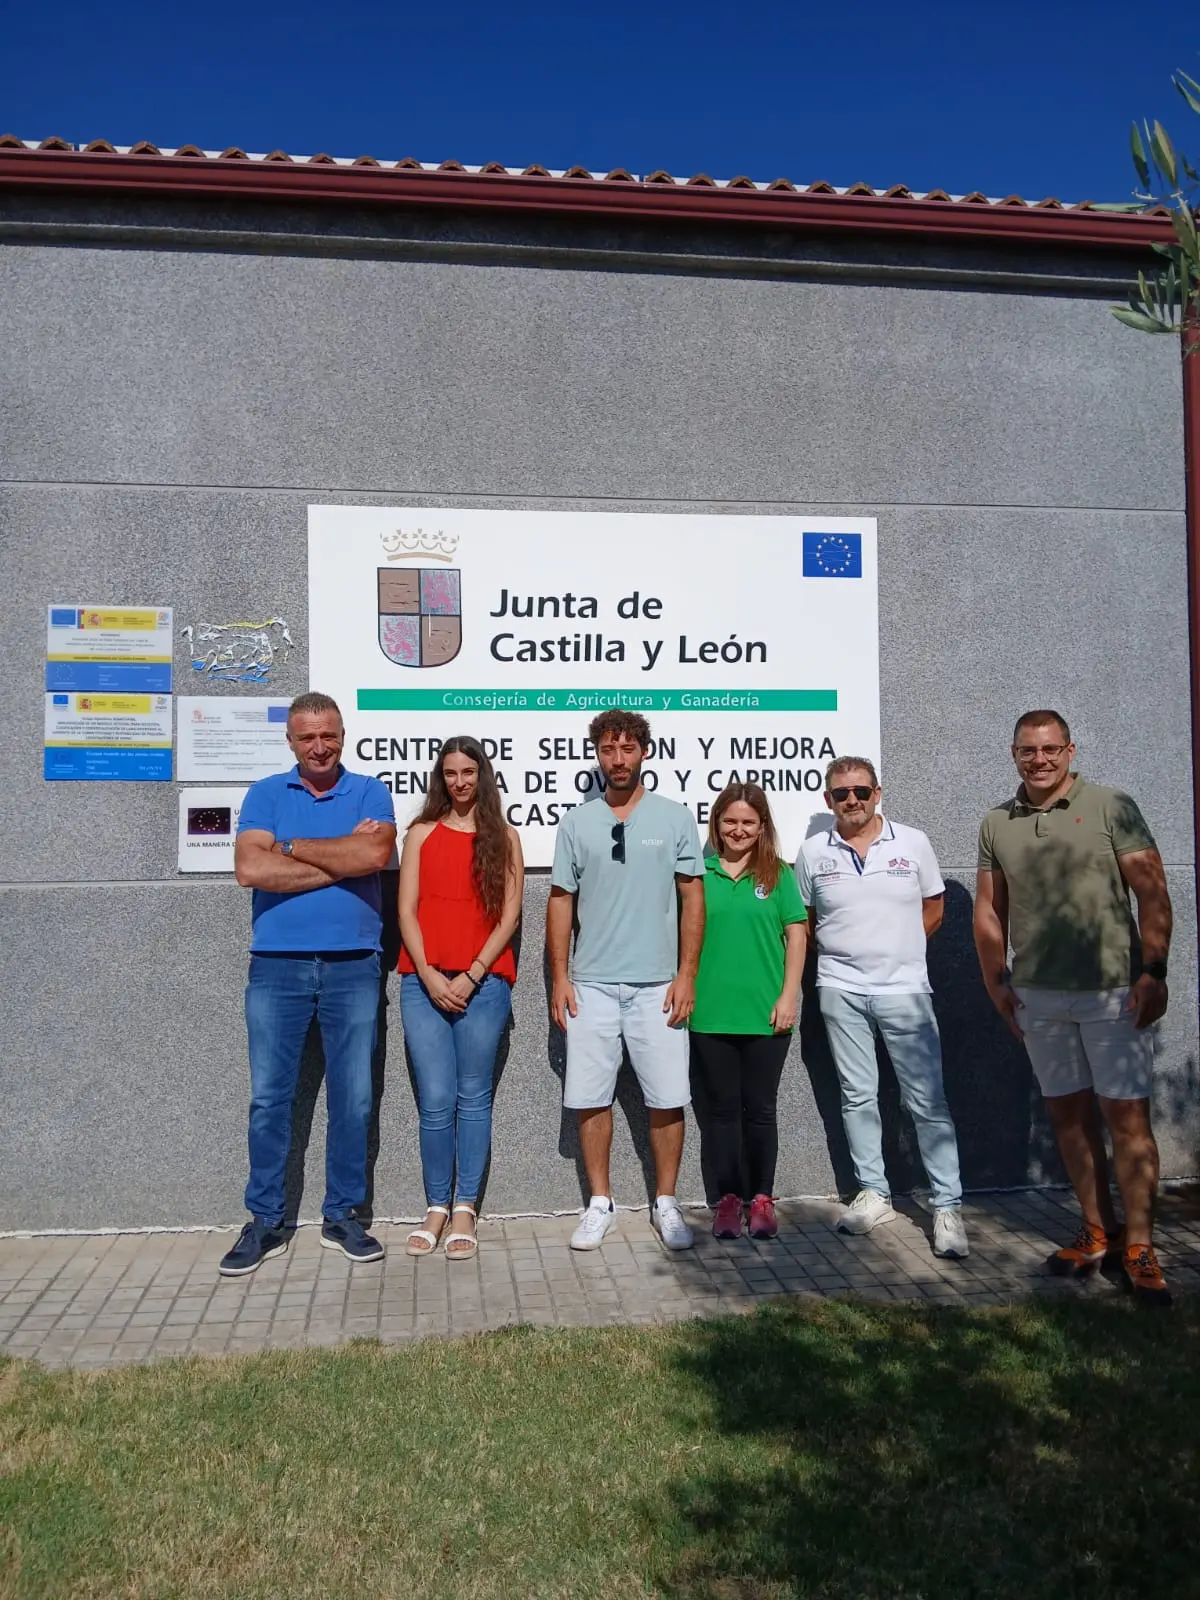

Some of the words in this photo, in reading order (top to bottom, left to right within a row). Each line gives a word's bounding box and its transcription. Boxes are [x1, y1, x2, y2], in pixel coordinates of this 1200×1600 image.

[489, 588, 598, 619] Junta
[616, 591, 663, 620] de
[489, 632, 625, 663] Castilla
[641, 640, 664, 672] y
[678, 633, 767, 664] León
[442, 692, 528, 709] Consejería
[536, 692, 556, 706] de
[565, 692, 654, 709] Agricultura
[662, 697, 672, 710] y
[681, 693, 759, 707] Ganadería
[356, 738, 442, 761] CENTR
[481, 738, 512, 761] DE
[697, 737, 715, 760] Y
[729, 736, 837, 760] MEJORA
[524, 770, 558, 794] DE
[674, 769, 692, 793] Y
[707, 769, 822, 792] CAPRINO
